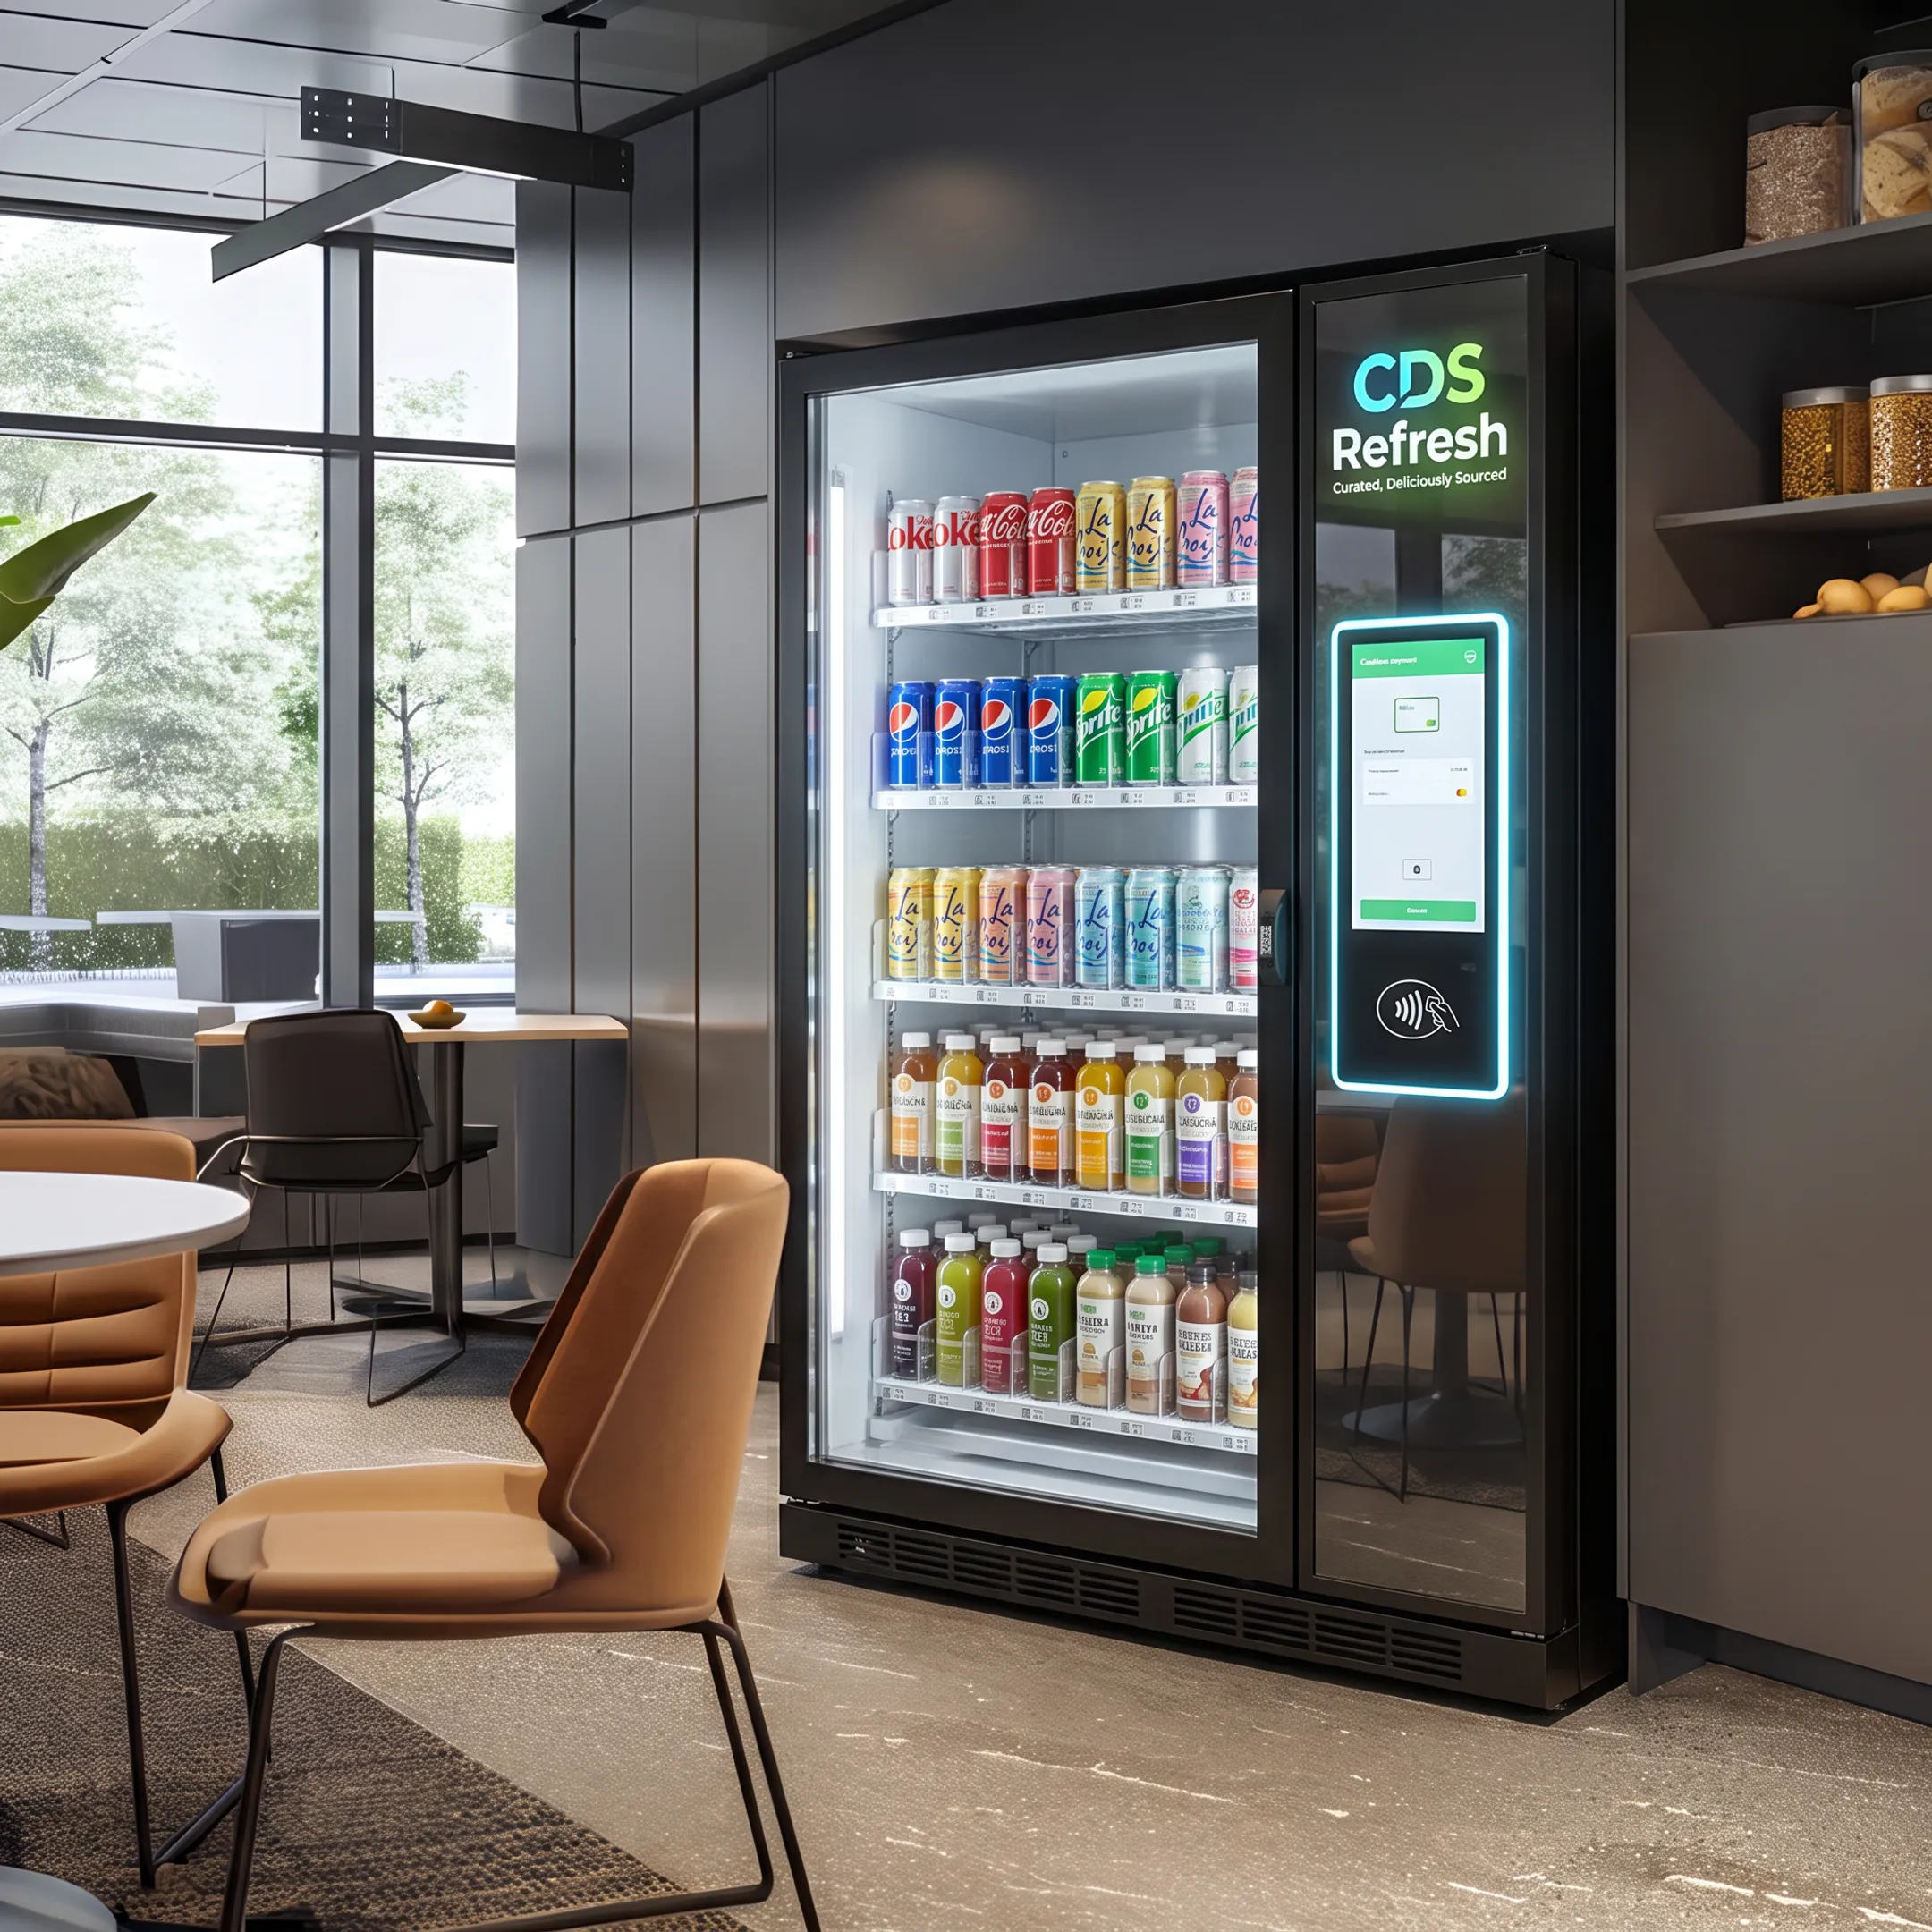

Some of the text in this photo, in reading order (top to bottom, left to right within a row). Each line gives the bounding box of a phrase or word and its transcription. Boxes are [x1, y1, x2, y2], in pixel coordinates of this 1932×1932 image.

[1353, 343, 1485, 413] CDS
[1333, 411, 1507, 470] Refresh
[1333, 466, 1507, 494] Curated, Deliciously Sourced
[1085, 497, 1111, 538] La
[1136, 494, 1163, 534] La
[1190, 488, 1218, 530] La
[889, 516, 934, 550] oke
